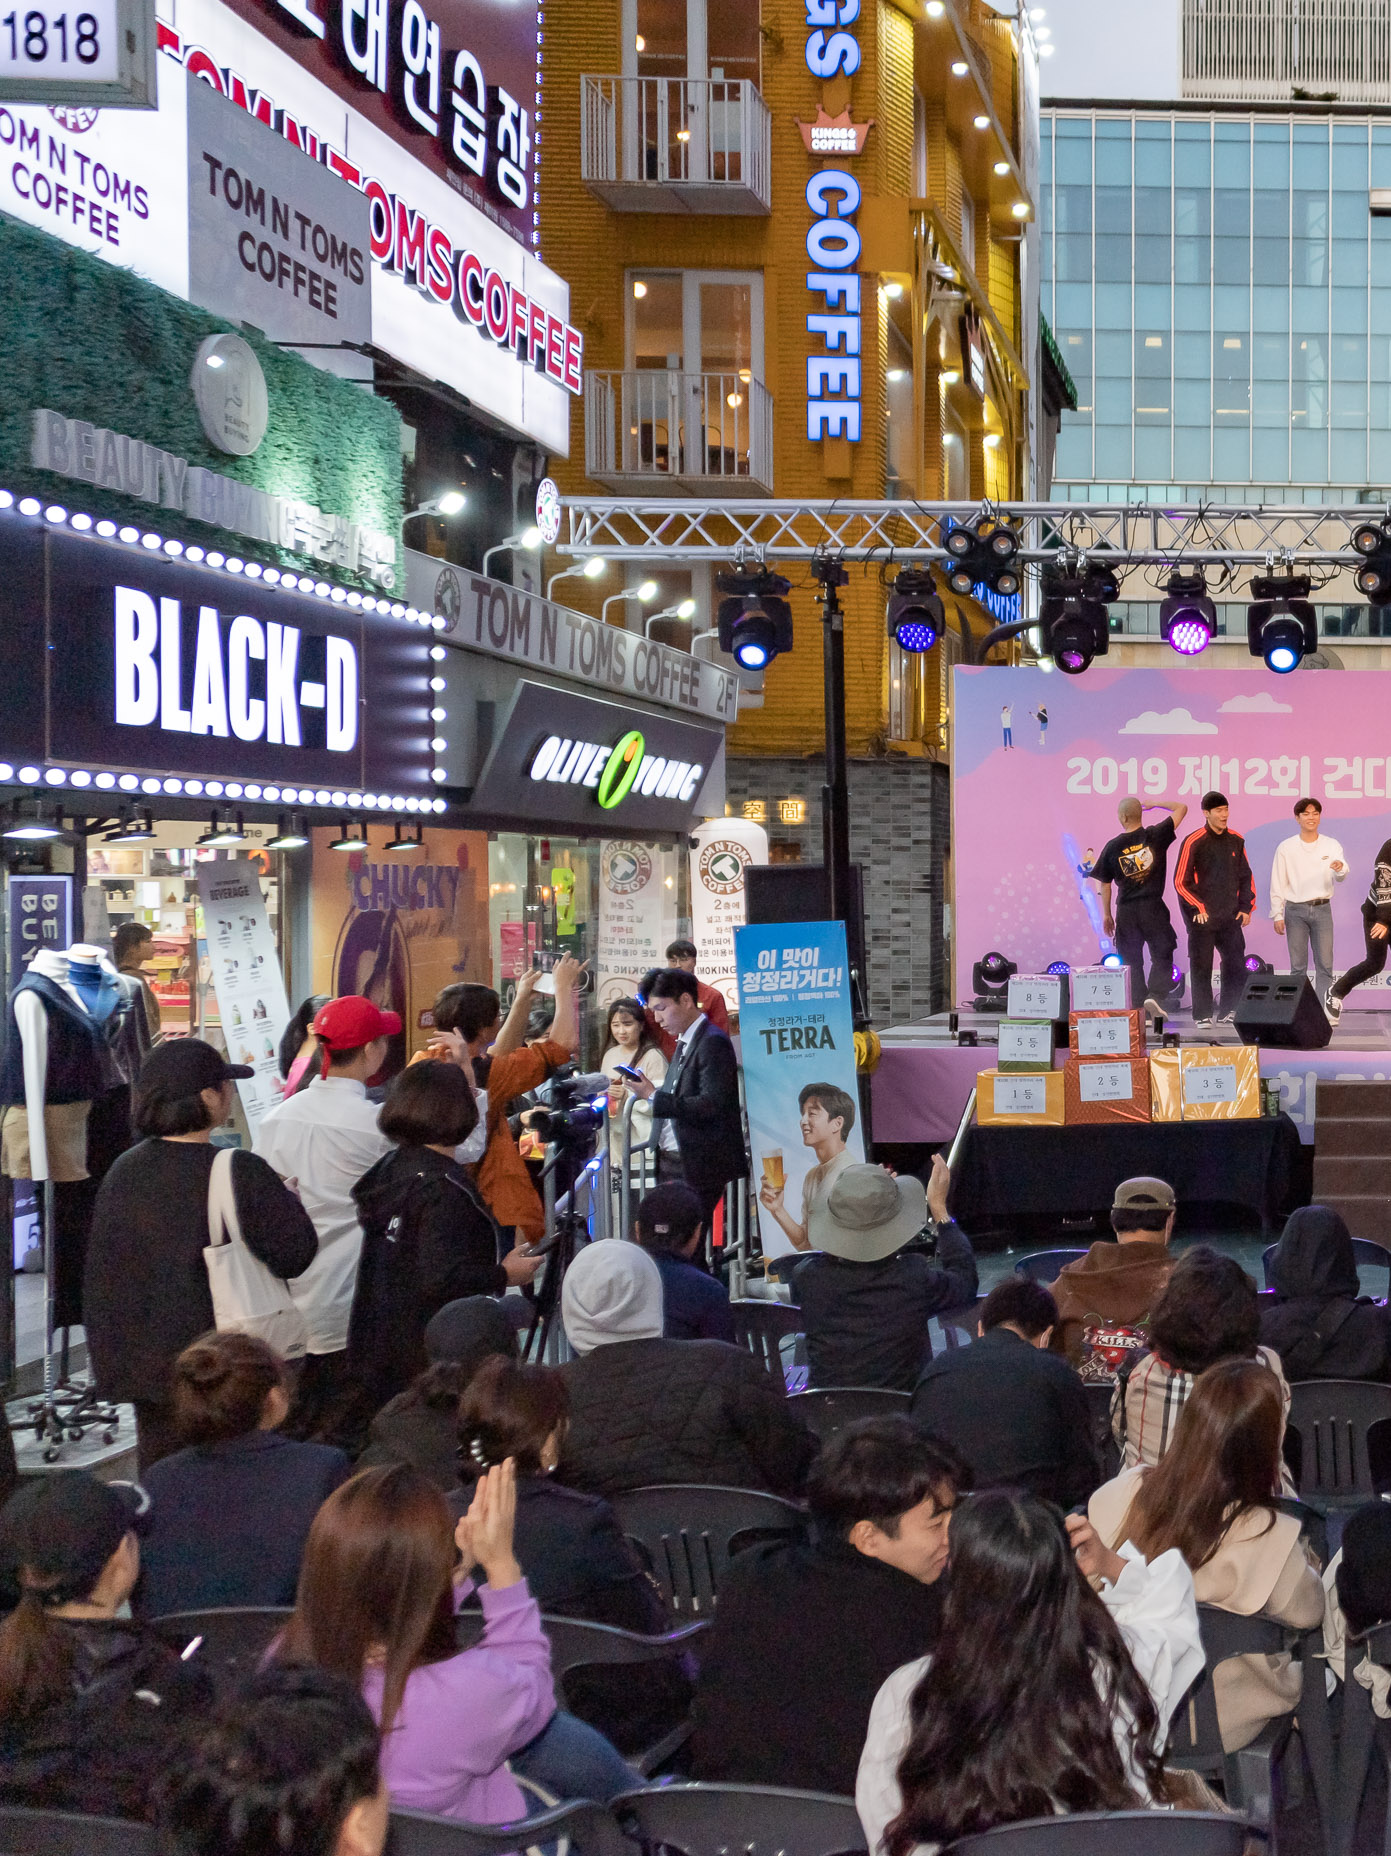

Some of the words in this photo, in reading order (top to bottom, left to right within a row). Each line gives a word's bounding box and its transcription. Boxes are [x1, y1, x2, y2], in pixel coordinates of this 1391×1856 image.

[2, 11, 100, 64] 1818
[811, 139, 857, 151] COFFEE
[49, 135, 66, 176] N
[73, 149, 149, 220] TOMS
[12, 162, 120, 247] COFFEE
[203, 151, 265, 227] TOM
[272, 195, 290, 242] N
[295, 210, 364, 286] TOMS
[238, 230, 338, 320] COFFEE
[458, 249, 583, 395] COFFEE
[805, 170, 861, 442] COFFEE
[34, 408, 187, 511] BEAUTY
[470, 577, 531, 657] TOM
[539, 608, 559, 666] N
[565, 616, 627, 685] TOMS
[632, 648, 701, 708] COFFEE
[715, 673, 735, 714] 2F
[114, 585, 359, 753] BLACK-D
[529, 735, 613, 787] OLIVE
[630, 754, 704, 802] YOUNG
[1066, 757, 1168, 795] 2019
[1178, 755, 1311, 799] 제12회
[353, 863, 460, 912] CHUCKY
[742, 967, 843, 993] 청정라거다!
[757, 949, 777, 970] 이
[782, 947, 819, 969] 맛이
[1026, 993, 1032, 1002] 8
[1037, 993, 1048, 1004] 등
[1091, 986, 1098, 995] 7
[1103, 985, 1113, 996] 등
[759, 1024, 837, 1056] TERRA
[1017, 1037, 1023, 1047] 5
[1028, 1037, 1039, 1048] 등
[1096, 1030, 1102, 1040] 4
[1023, 1089, 1033, 1100] 등
[1097, 1076, 1104, 1086] 2
[1109, 1075, 1119, 1087] 등
[1203, 1079, 1209, 1089] 3
[1213, 1078, 1225, 1090] 등
[1096, 1335, 1139, 1348] KILLS
